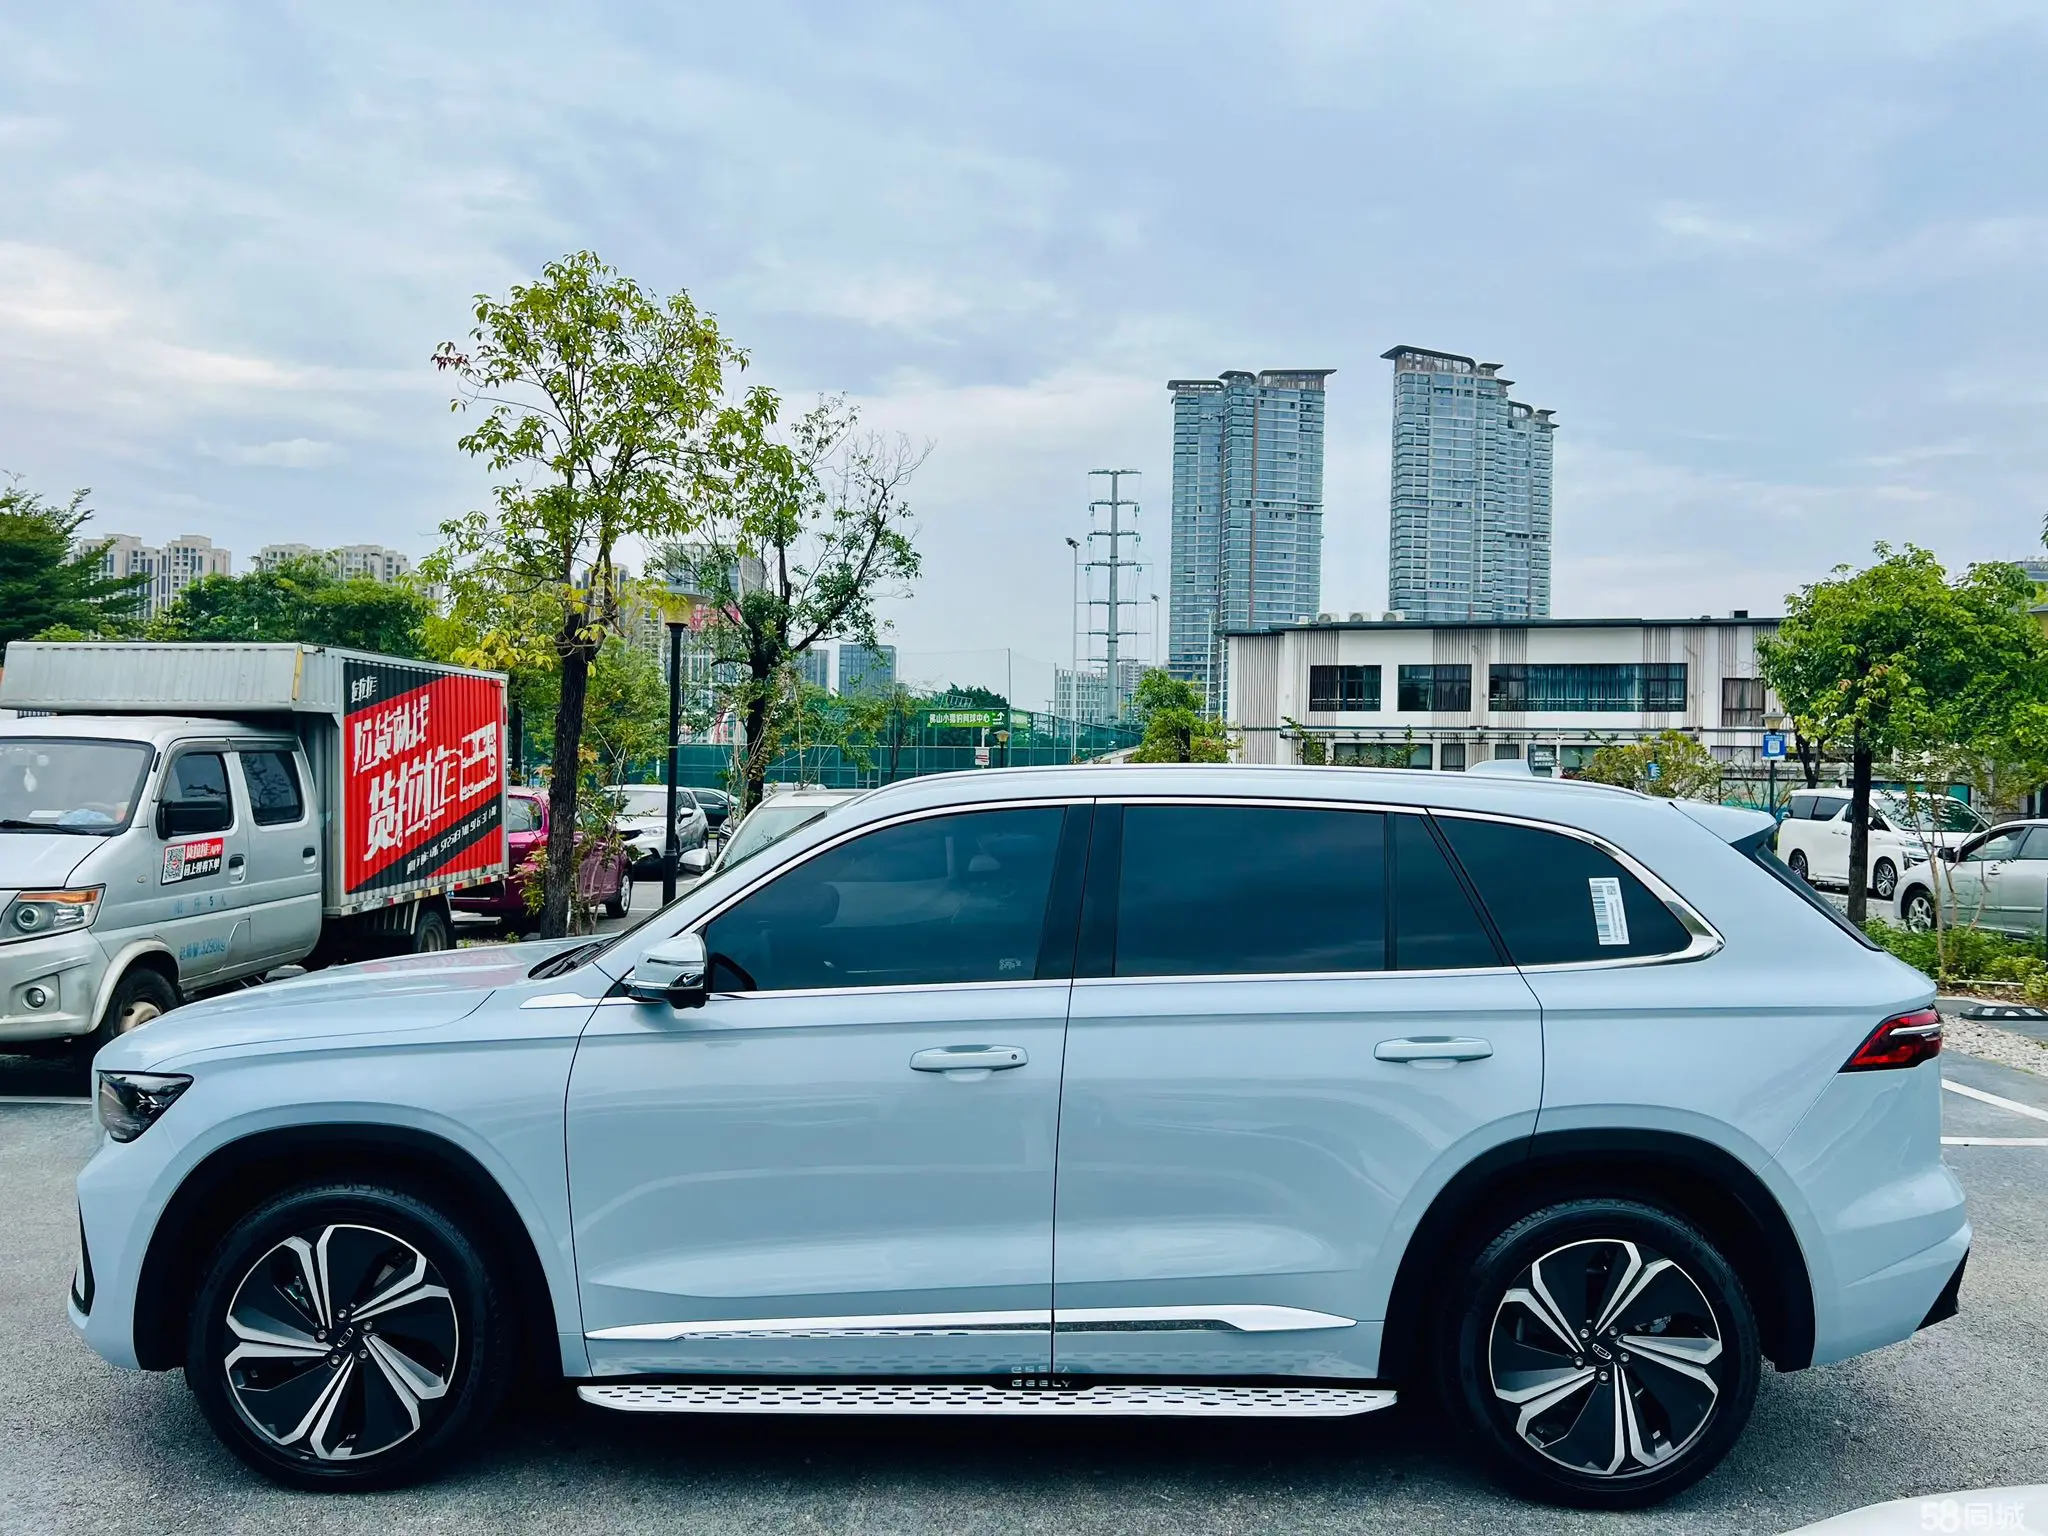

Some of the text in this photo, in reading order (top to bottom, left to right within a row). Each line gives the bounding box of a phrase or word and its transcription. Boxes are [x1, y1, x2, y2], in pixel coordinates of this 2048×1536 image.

[353, 694, 430, 776] 拉货就找
[363, 744, 457, 861] 货拉拉
[1011, 1379, 1071, 1388] GEELY
